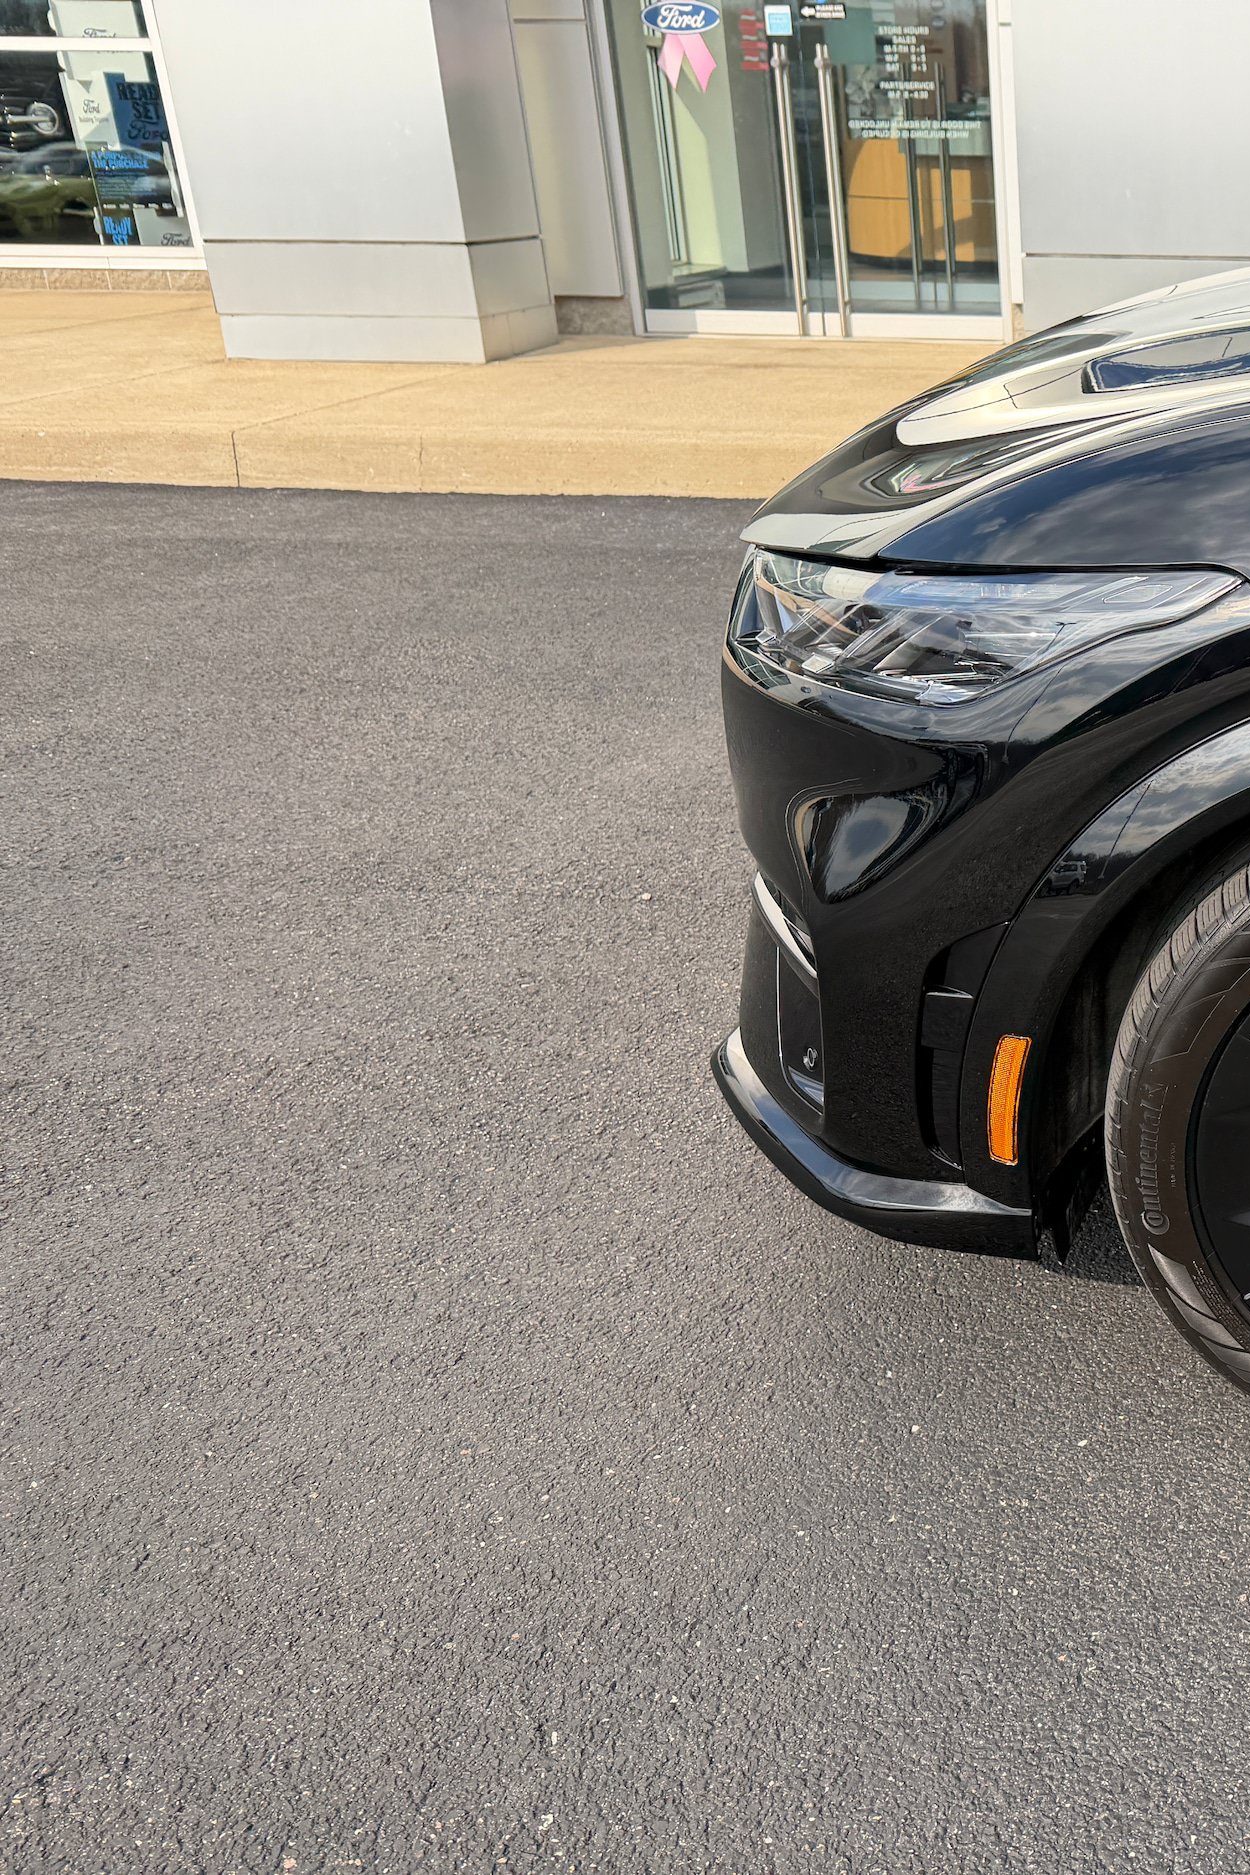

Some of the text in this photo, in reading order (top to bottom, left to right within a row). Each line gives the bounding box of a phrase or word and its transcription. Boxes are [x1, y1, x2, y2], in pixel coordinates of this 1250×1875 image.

[657, 4, 705, 28] Ford
[83, 100, 101, 114] Ford
[103, 216, 132, 235] READY
[161, 232, 190, 246] Ford
[1134, 1099, 1171, 1236] Continental
